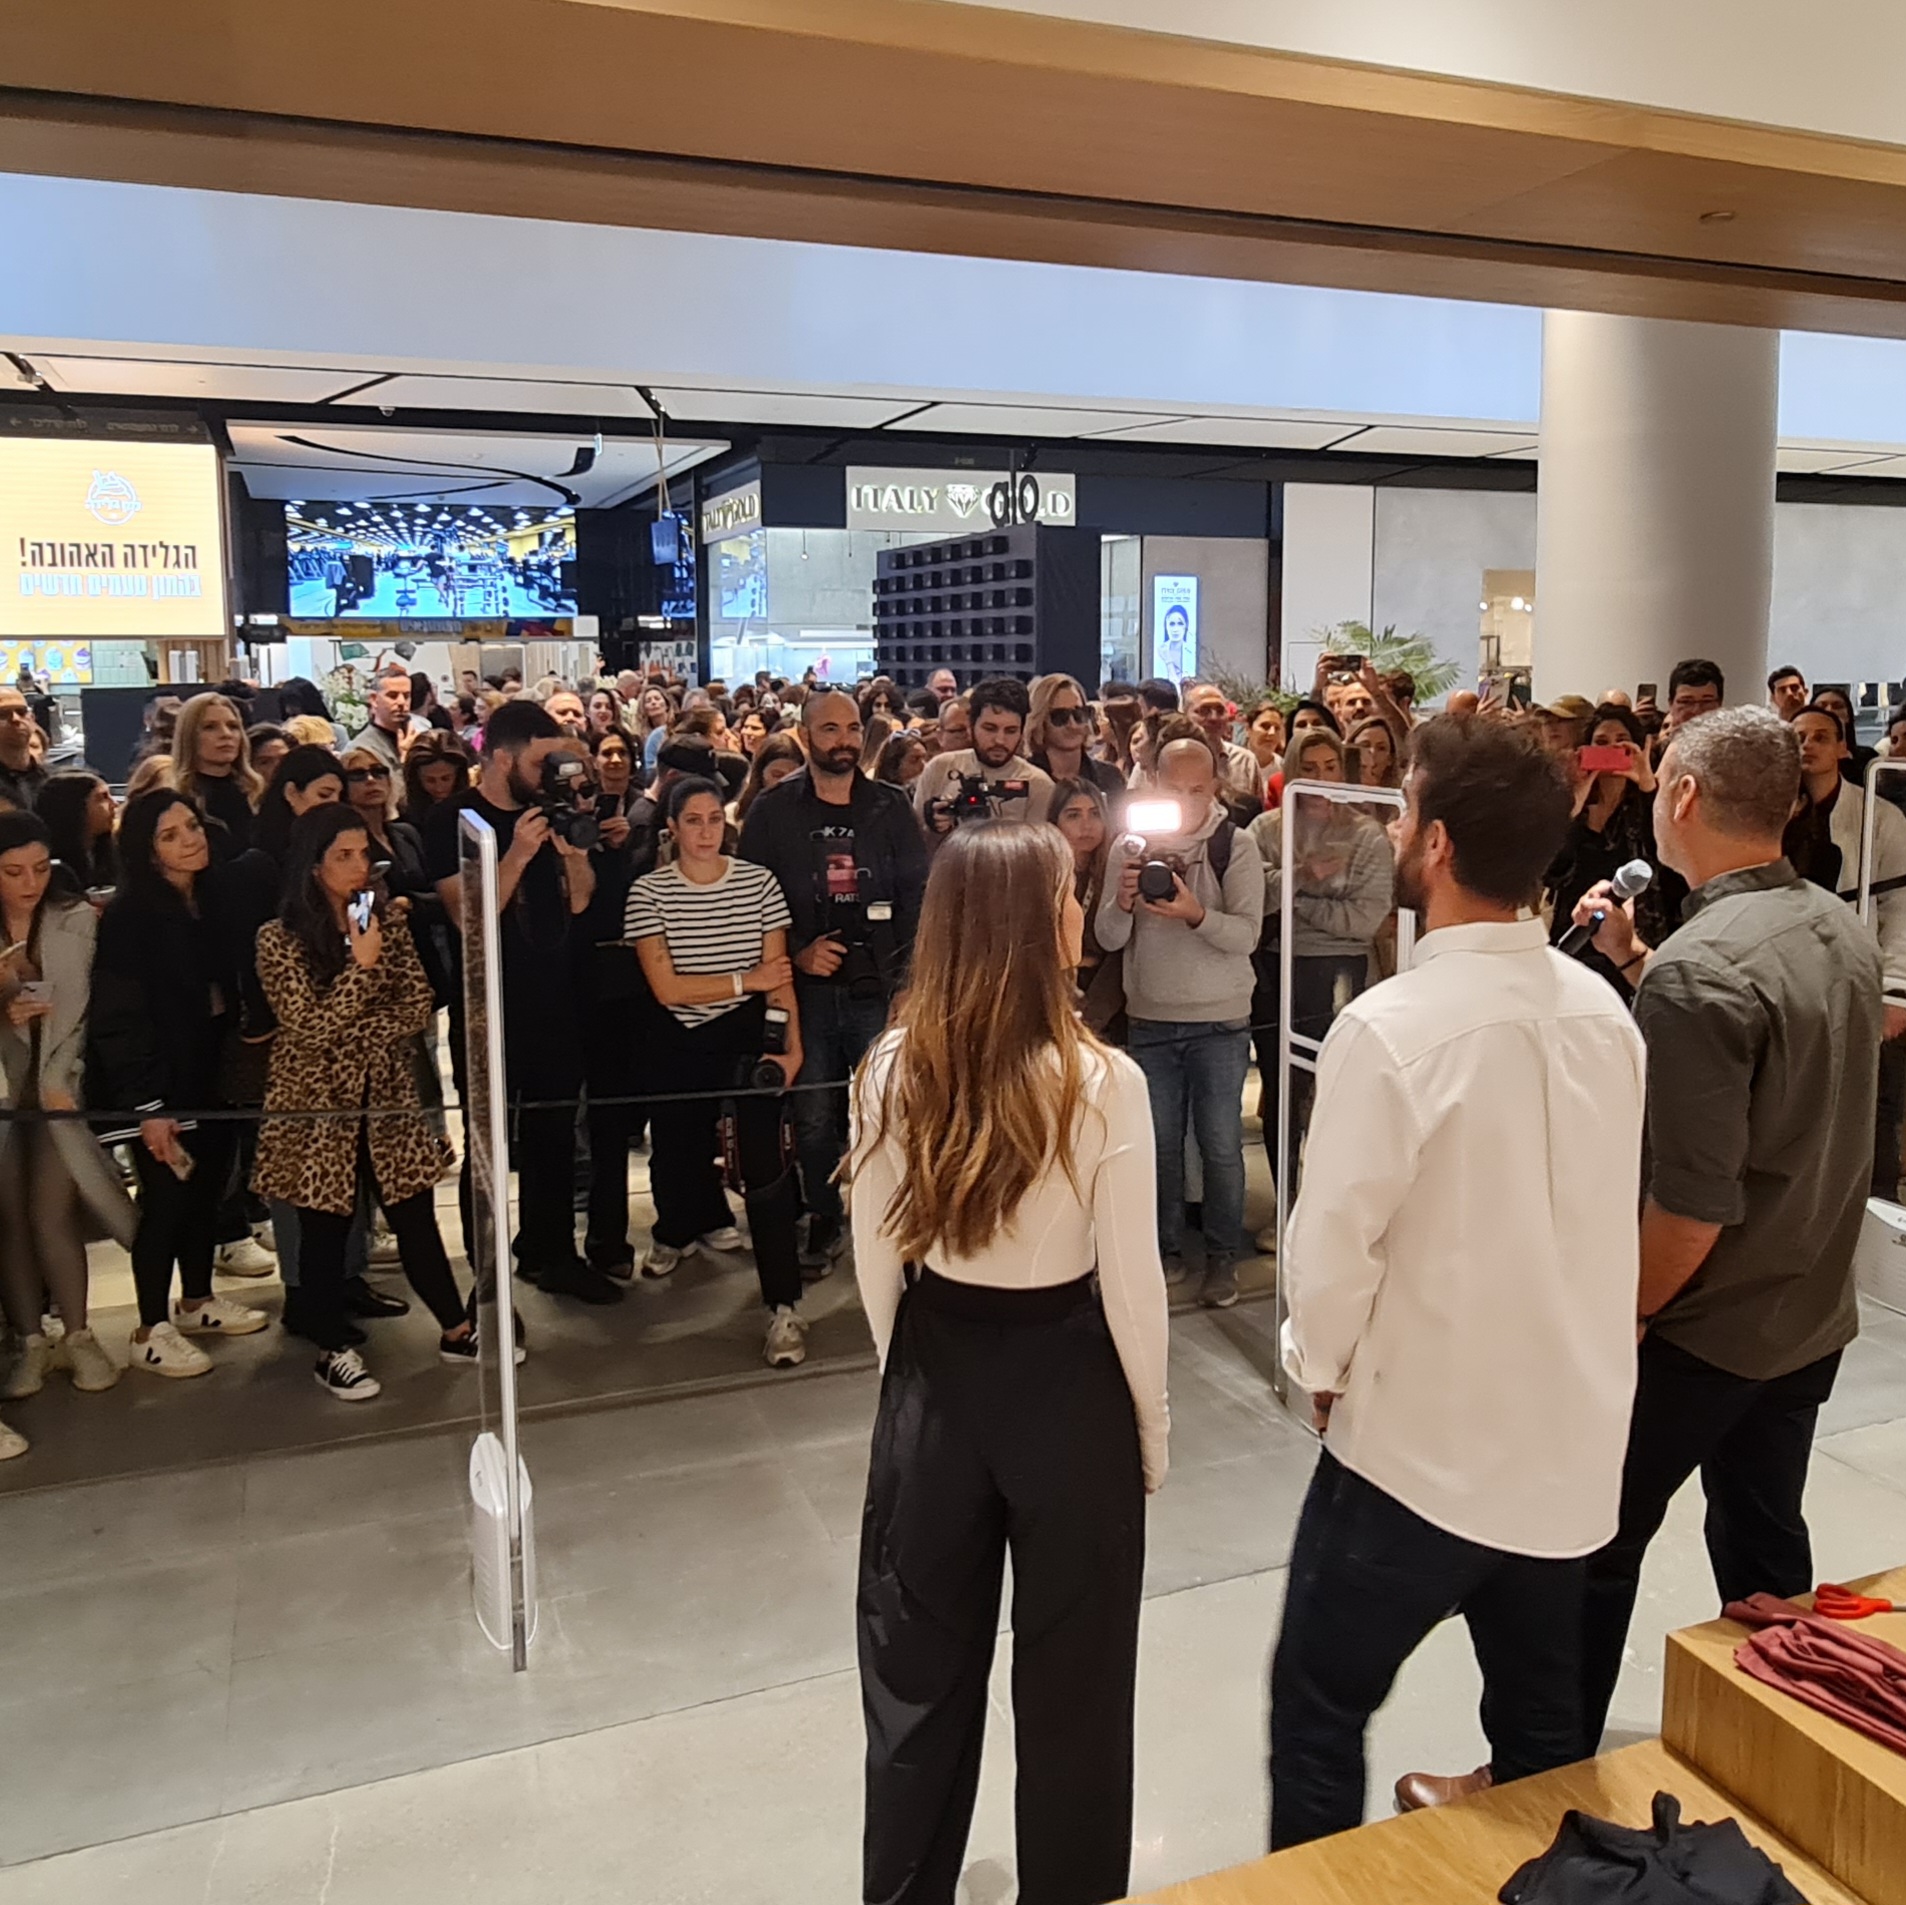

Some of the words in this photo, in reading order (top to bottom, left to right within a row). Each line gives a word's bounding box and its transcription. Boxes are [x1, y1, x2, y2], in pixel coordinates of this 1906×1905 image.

[851, 483, 940, 514] ITALY
[19, 537, 115, 568] האהובה!
[122, 540, 198, 569] הגלידה
